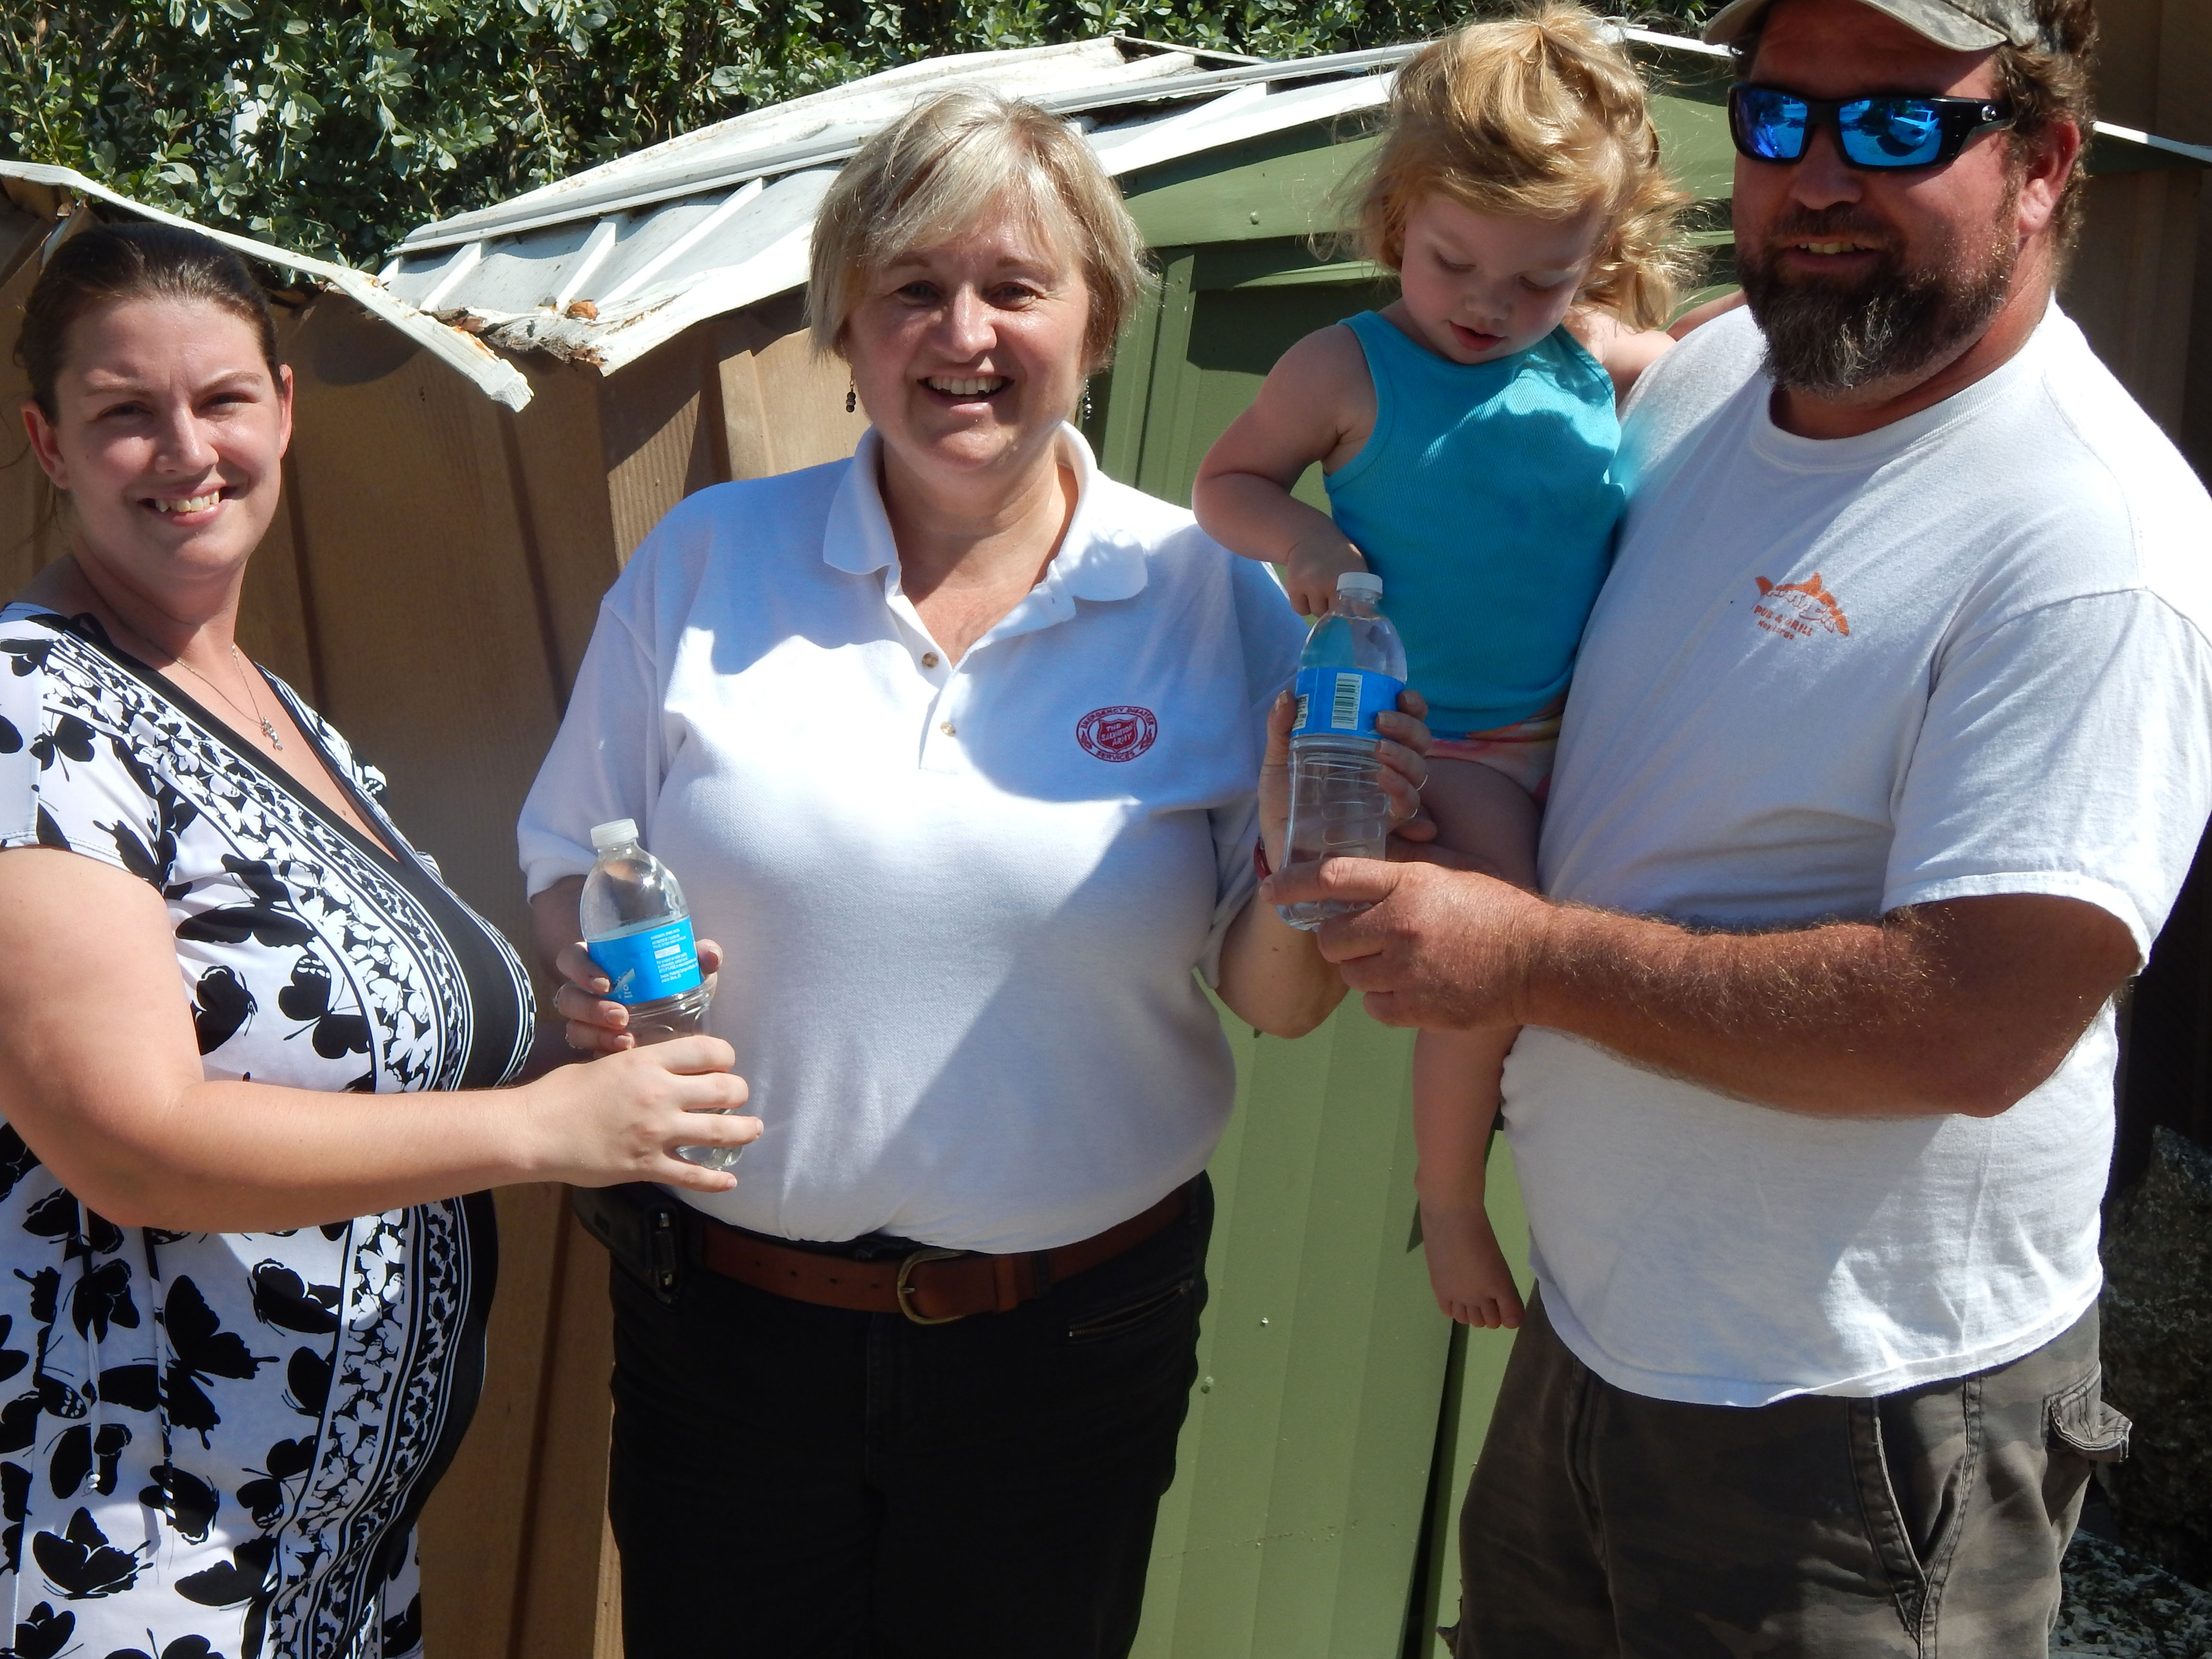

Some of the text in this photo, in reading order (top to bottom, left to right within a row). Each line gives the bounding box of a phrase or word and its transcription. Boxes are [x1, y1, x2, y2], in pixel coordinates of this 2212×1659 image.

[1754, 605, 1813, 637] PUB & GRILL
[1081, 708, 1124, 729] EMERGENCY
[1106, 723, 1121, 732] THE
[1101, 723, 1133, 742] SALVATION
[1112, 733, 1132, 746] ARMY
